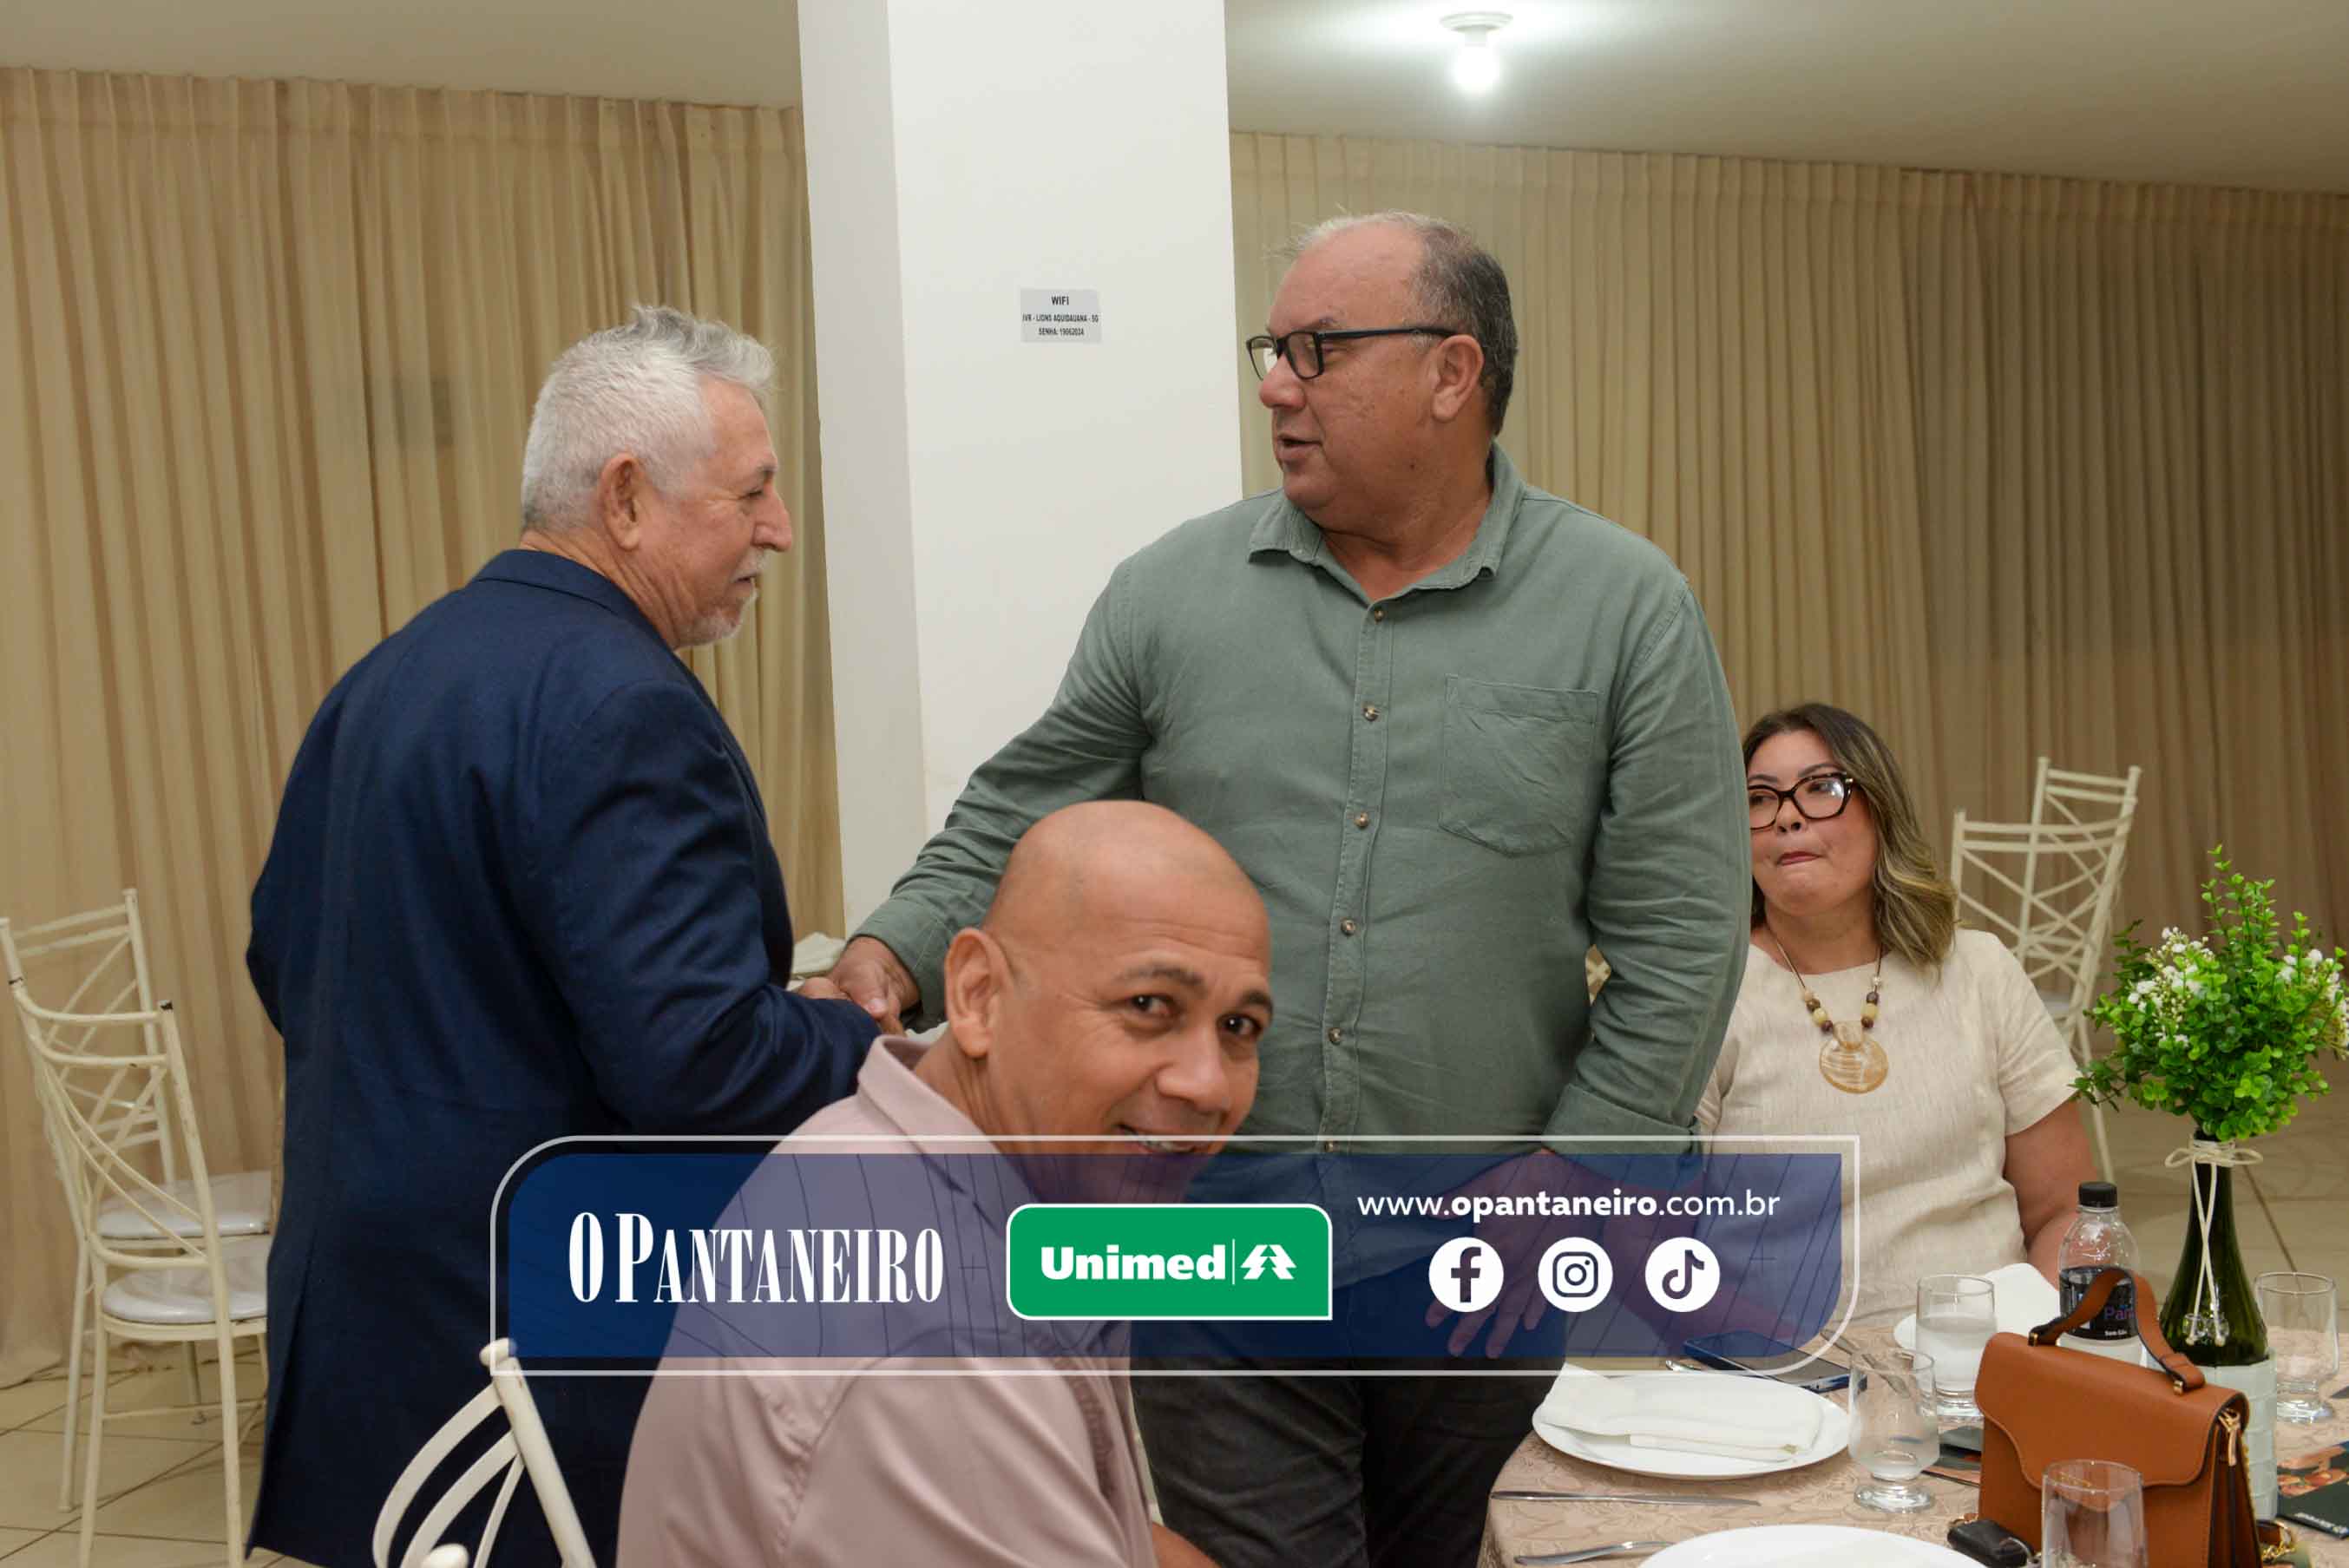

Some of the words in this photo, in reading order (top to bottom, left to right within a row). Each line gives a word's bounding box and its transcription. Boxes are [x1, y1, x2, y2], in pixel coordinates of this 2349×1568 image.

[1051, 296, 1069, 305] WIFI
[1036, 313, 1052, 322] LIONS
[1053, 313, 1087, 323] AQUIDAUANA
